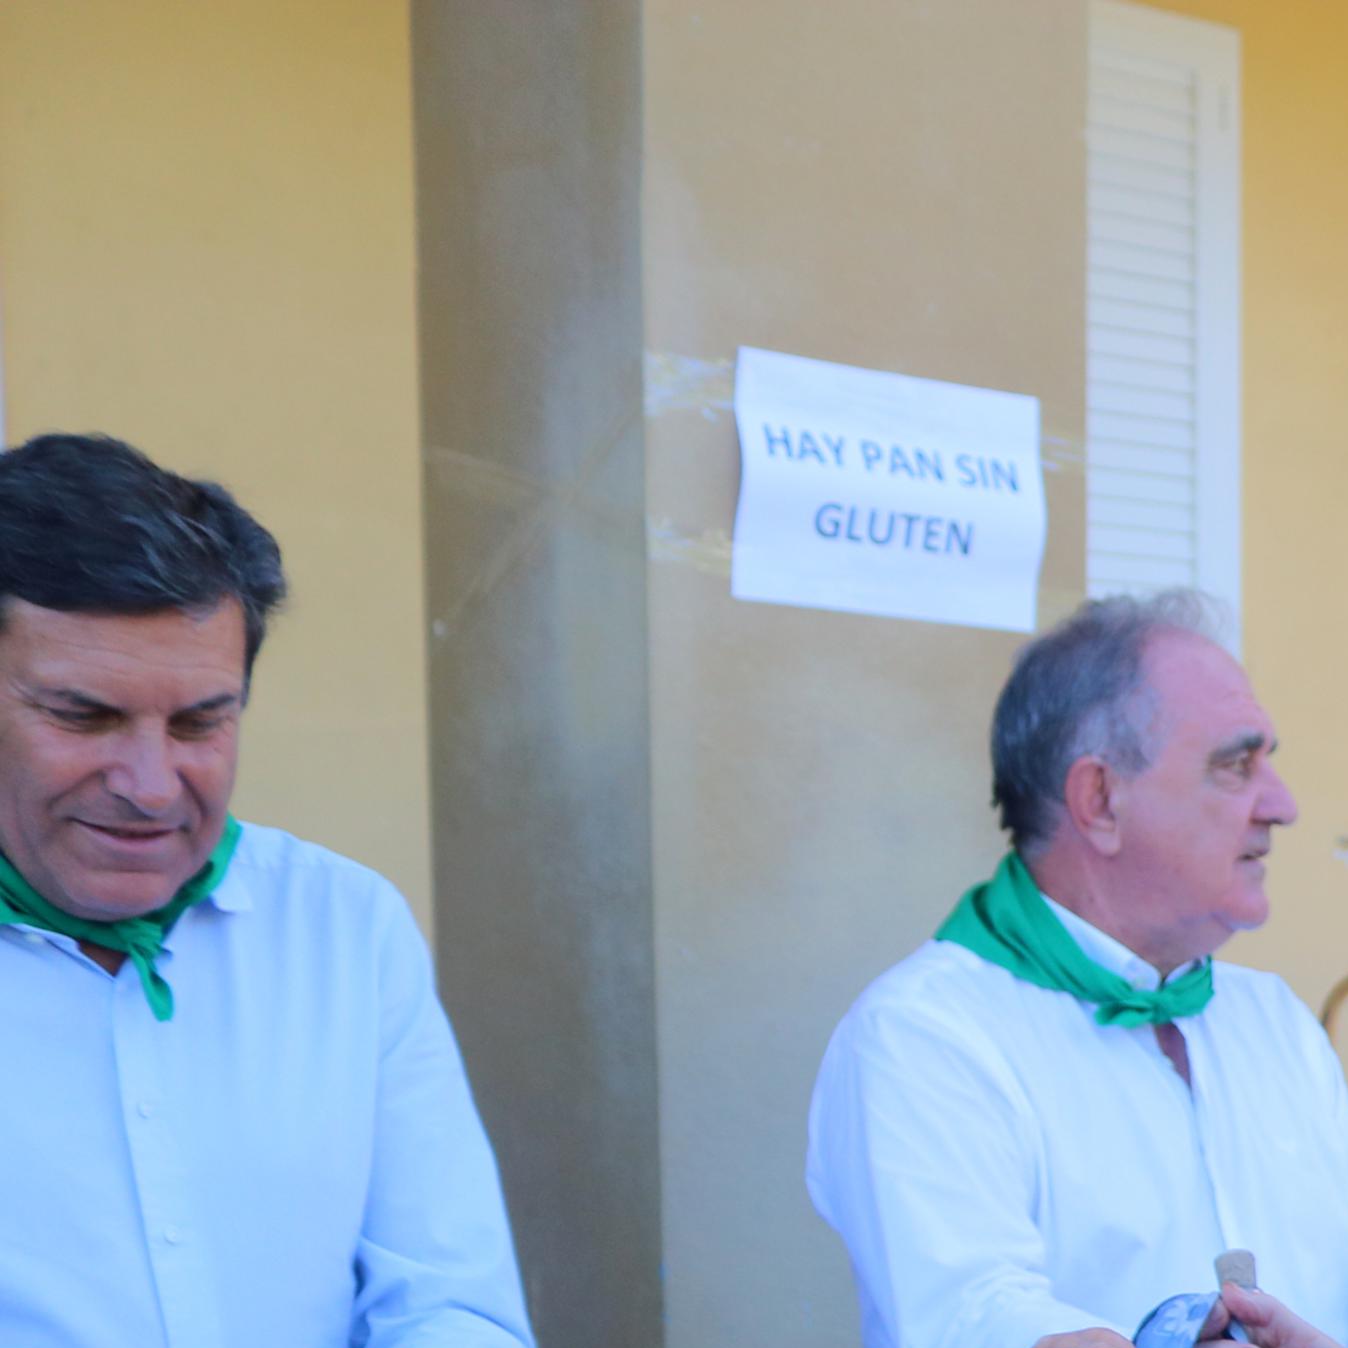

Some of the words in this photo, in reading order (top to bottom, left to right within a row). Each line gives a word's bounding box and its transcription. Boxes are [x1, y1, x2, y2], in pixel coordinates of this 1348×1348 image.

[762, 423, 846, 466] HAY
[861, 439, 945, 483] PAN
[955, 453, 1020, 494] SIN
[813, 502, 975, 557] GLUTEN
